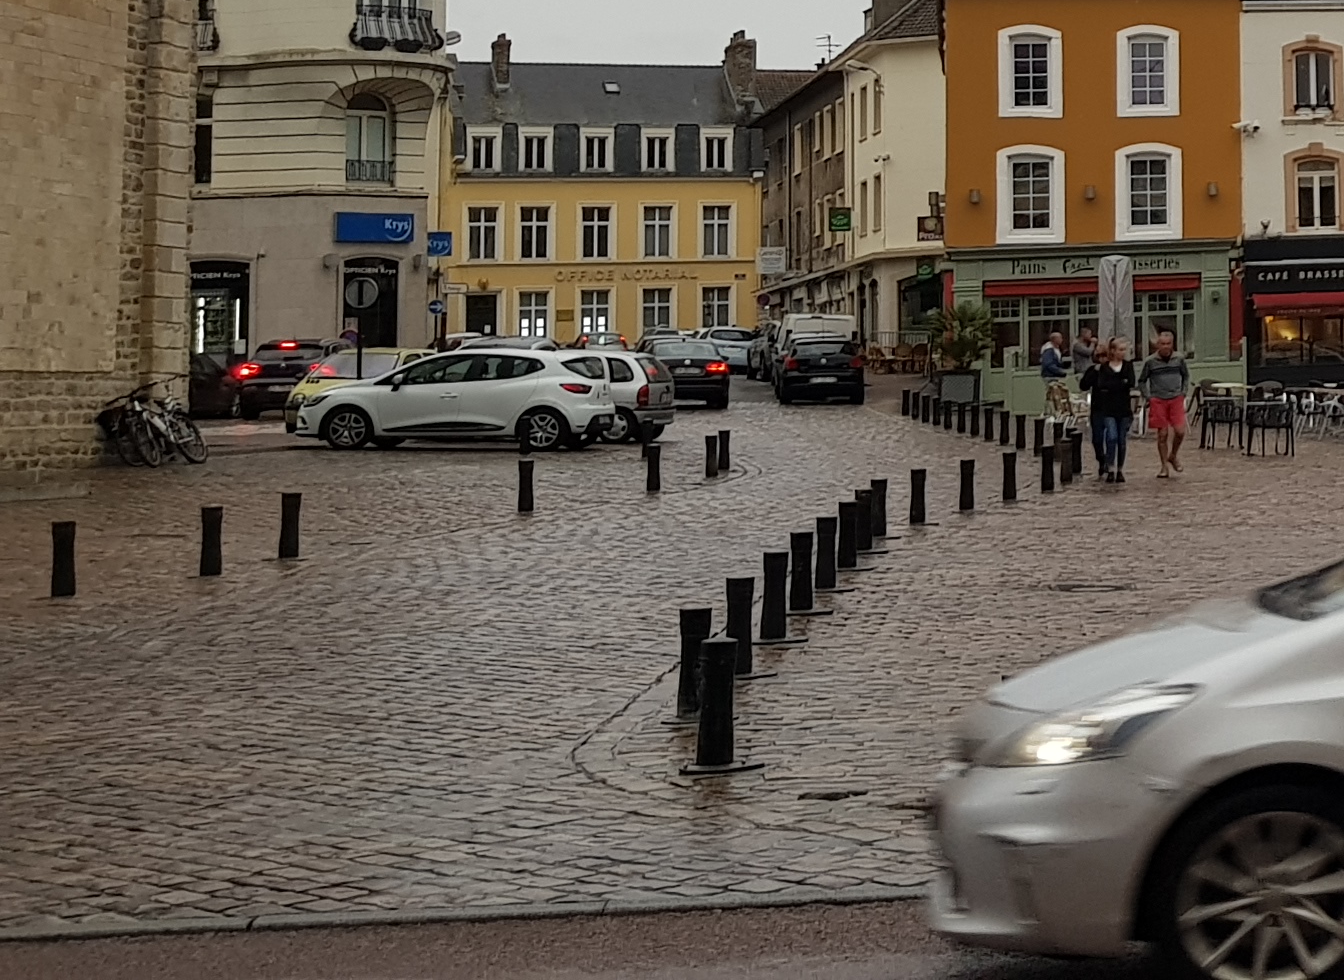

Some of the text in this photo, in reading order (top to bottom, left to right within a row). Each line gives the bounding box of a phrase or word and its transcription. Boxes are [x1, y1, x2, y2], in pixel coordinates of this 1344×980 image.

[384, 218, 410, 234] Krys
[428, 237, 449, 251] Krys
[1011, 258, 1047, 274] Pains
[1133, 257, 1180, 270] isseries
[554, 268, 699, 282] OFFICE NOTARIAL
[1258, 270, 1289, 281] CAFÉ
